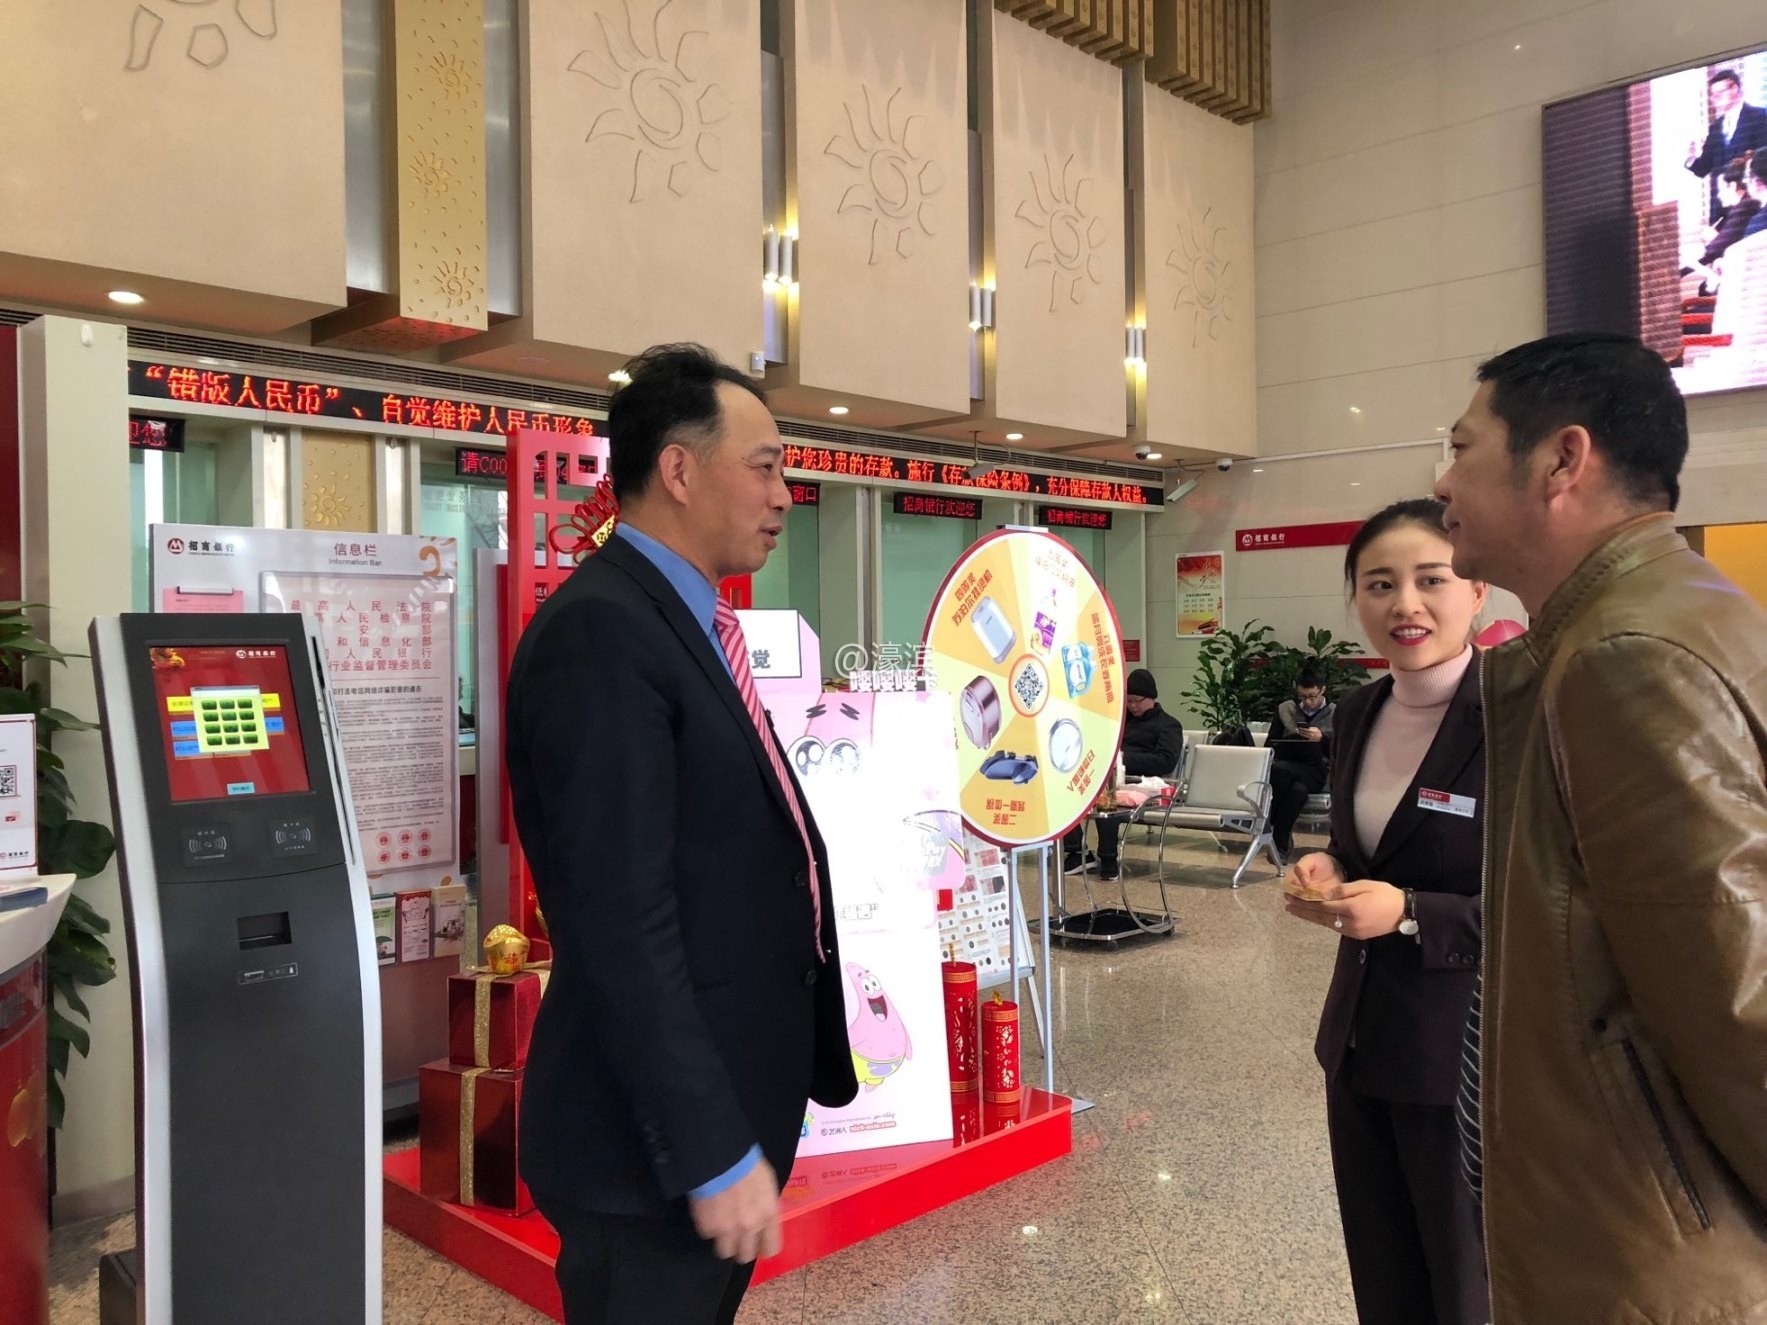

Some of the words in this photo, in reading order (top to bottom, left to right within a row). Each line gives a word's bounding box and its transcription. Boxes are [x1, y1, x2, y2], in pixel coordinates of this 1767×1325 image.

[903, 495, 976, 517] 招商银行欢迎您
[334, 542, 376, 556] 信息栏
[328, 558, 368, 566] Information
[747, 649, 770, 669] 觉
